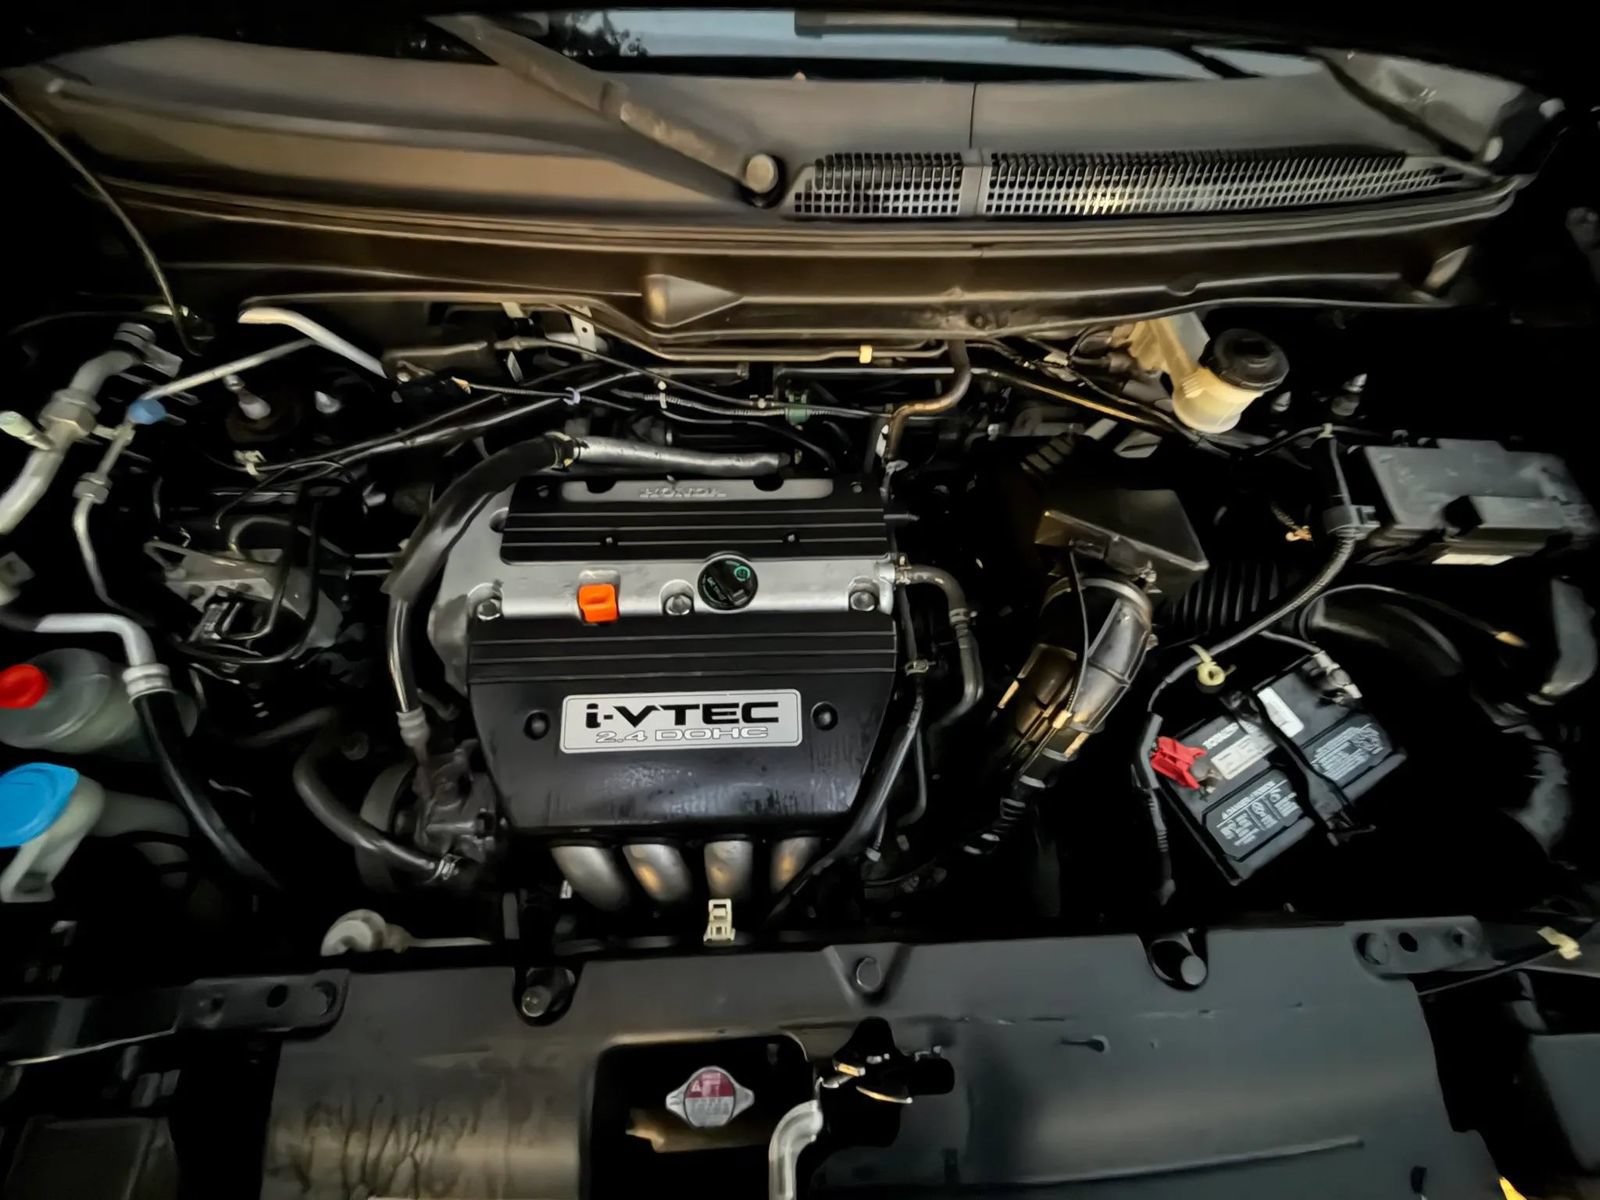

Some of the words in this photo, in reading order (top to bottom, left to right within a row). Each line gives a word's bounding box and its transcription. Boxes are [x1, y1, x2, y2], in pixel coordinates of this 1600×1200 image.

[586, 702, 779, 729] i-VTEC
[596, 730, 648, 744] 2.4
[655, 726, 769, 742] DOHC
